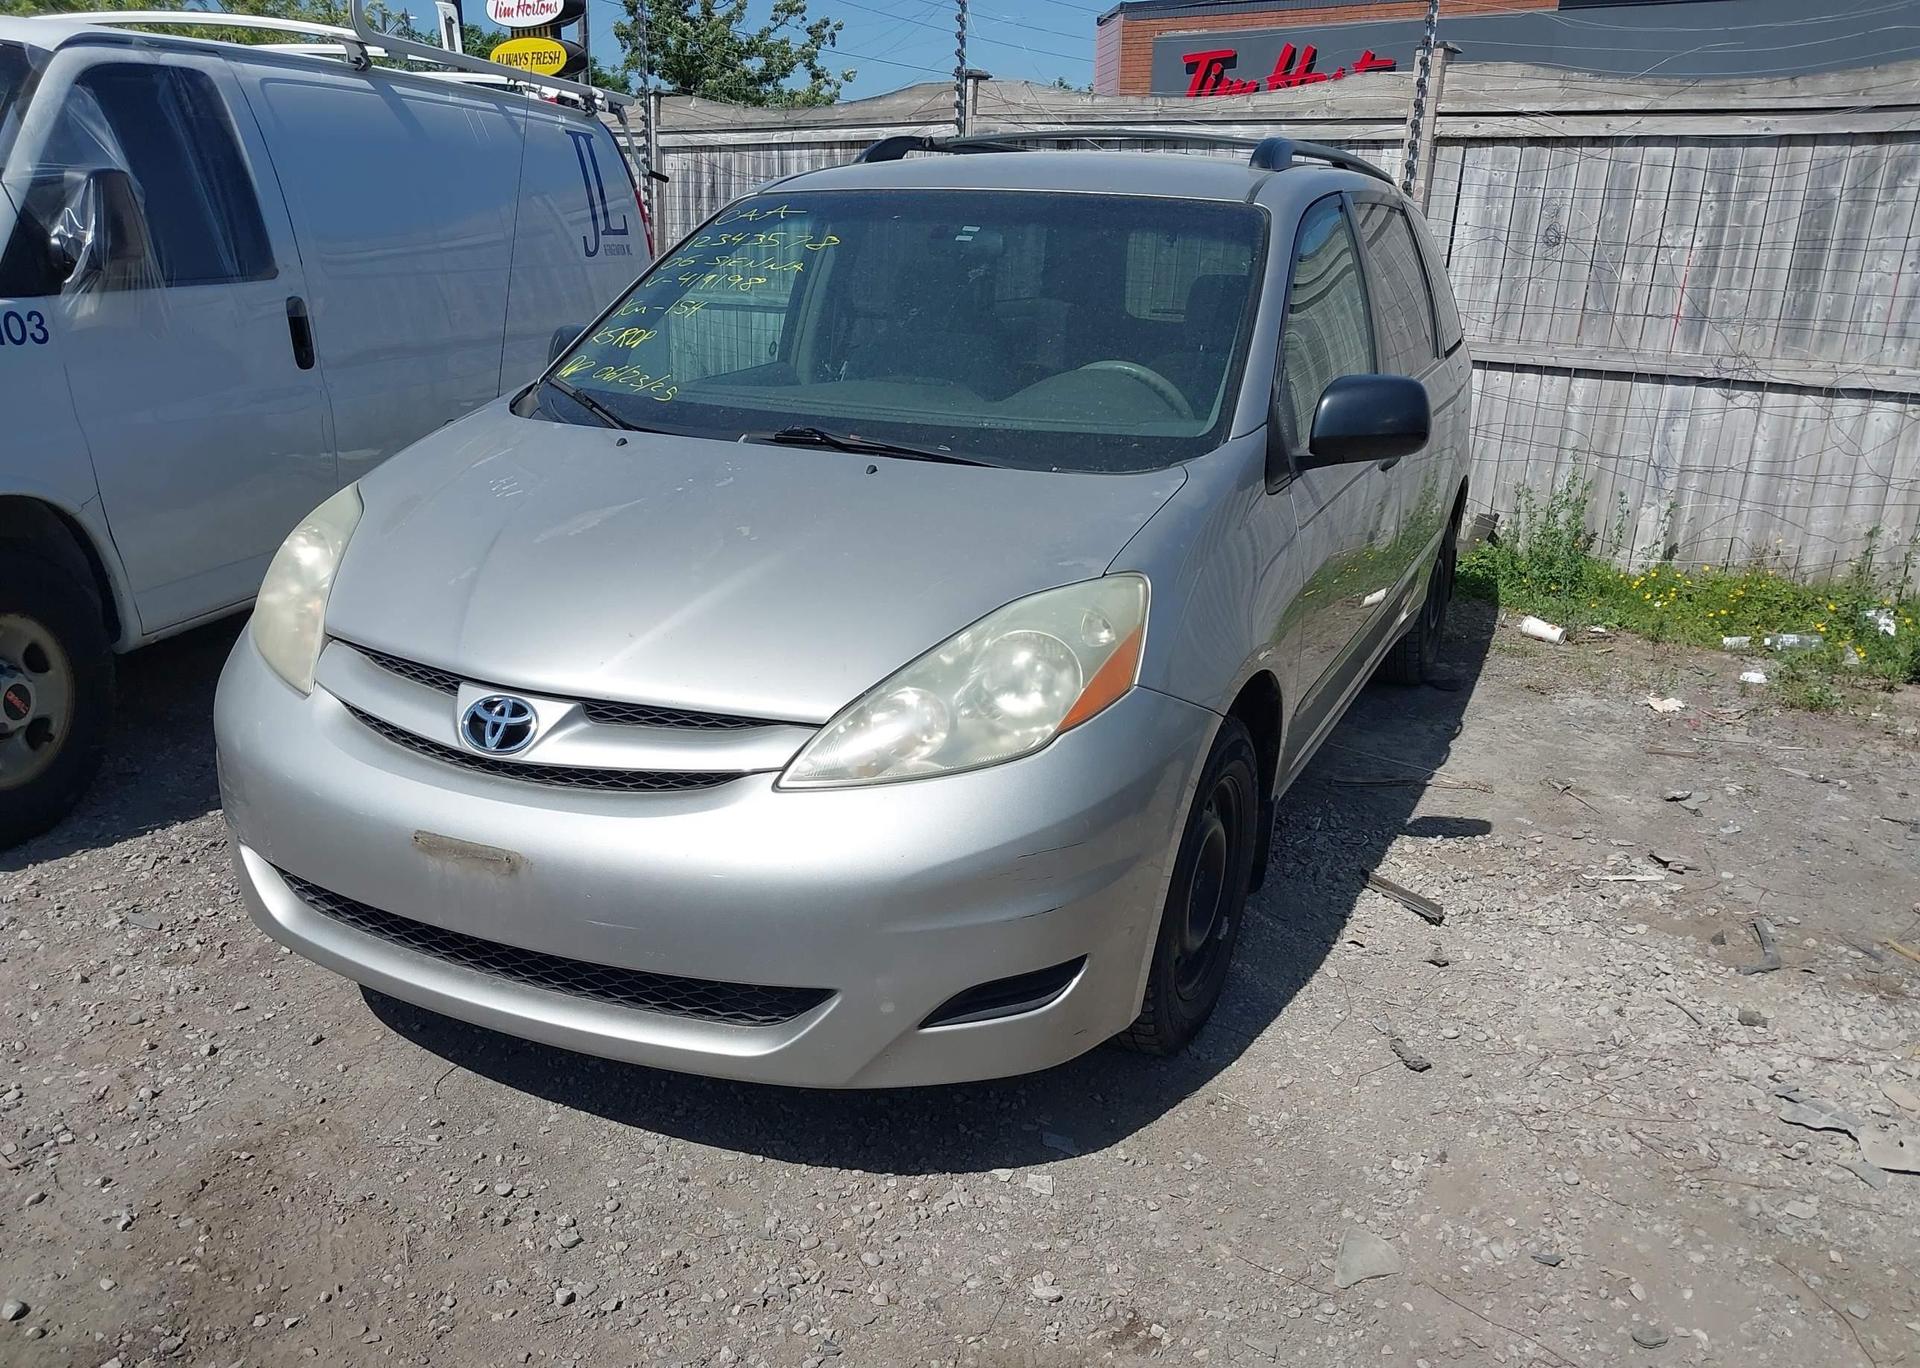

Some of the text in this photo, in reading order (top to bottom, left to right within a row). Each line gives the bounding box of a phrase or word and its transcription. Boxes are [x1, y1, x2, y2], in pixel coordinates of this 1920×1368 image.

[493, 0, 558, 19] Tim Hortons
[496, 51, 561, 66] ALWAYS FRESH
